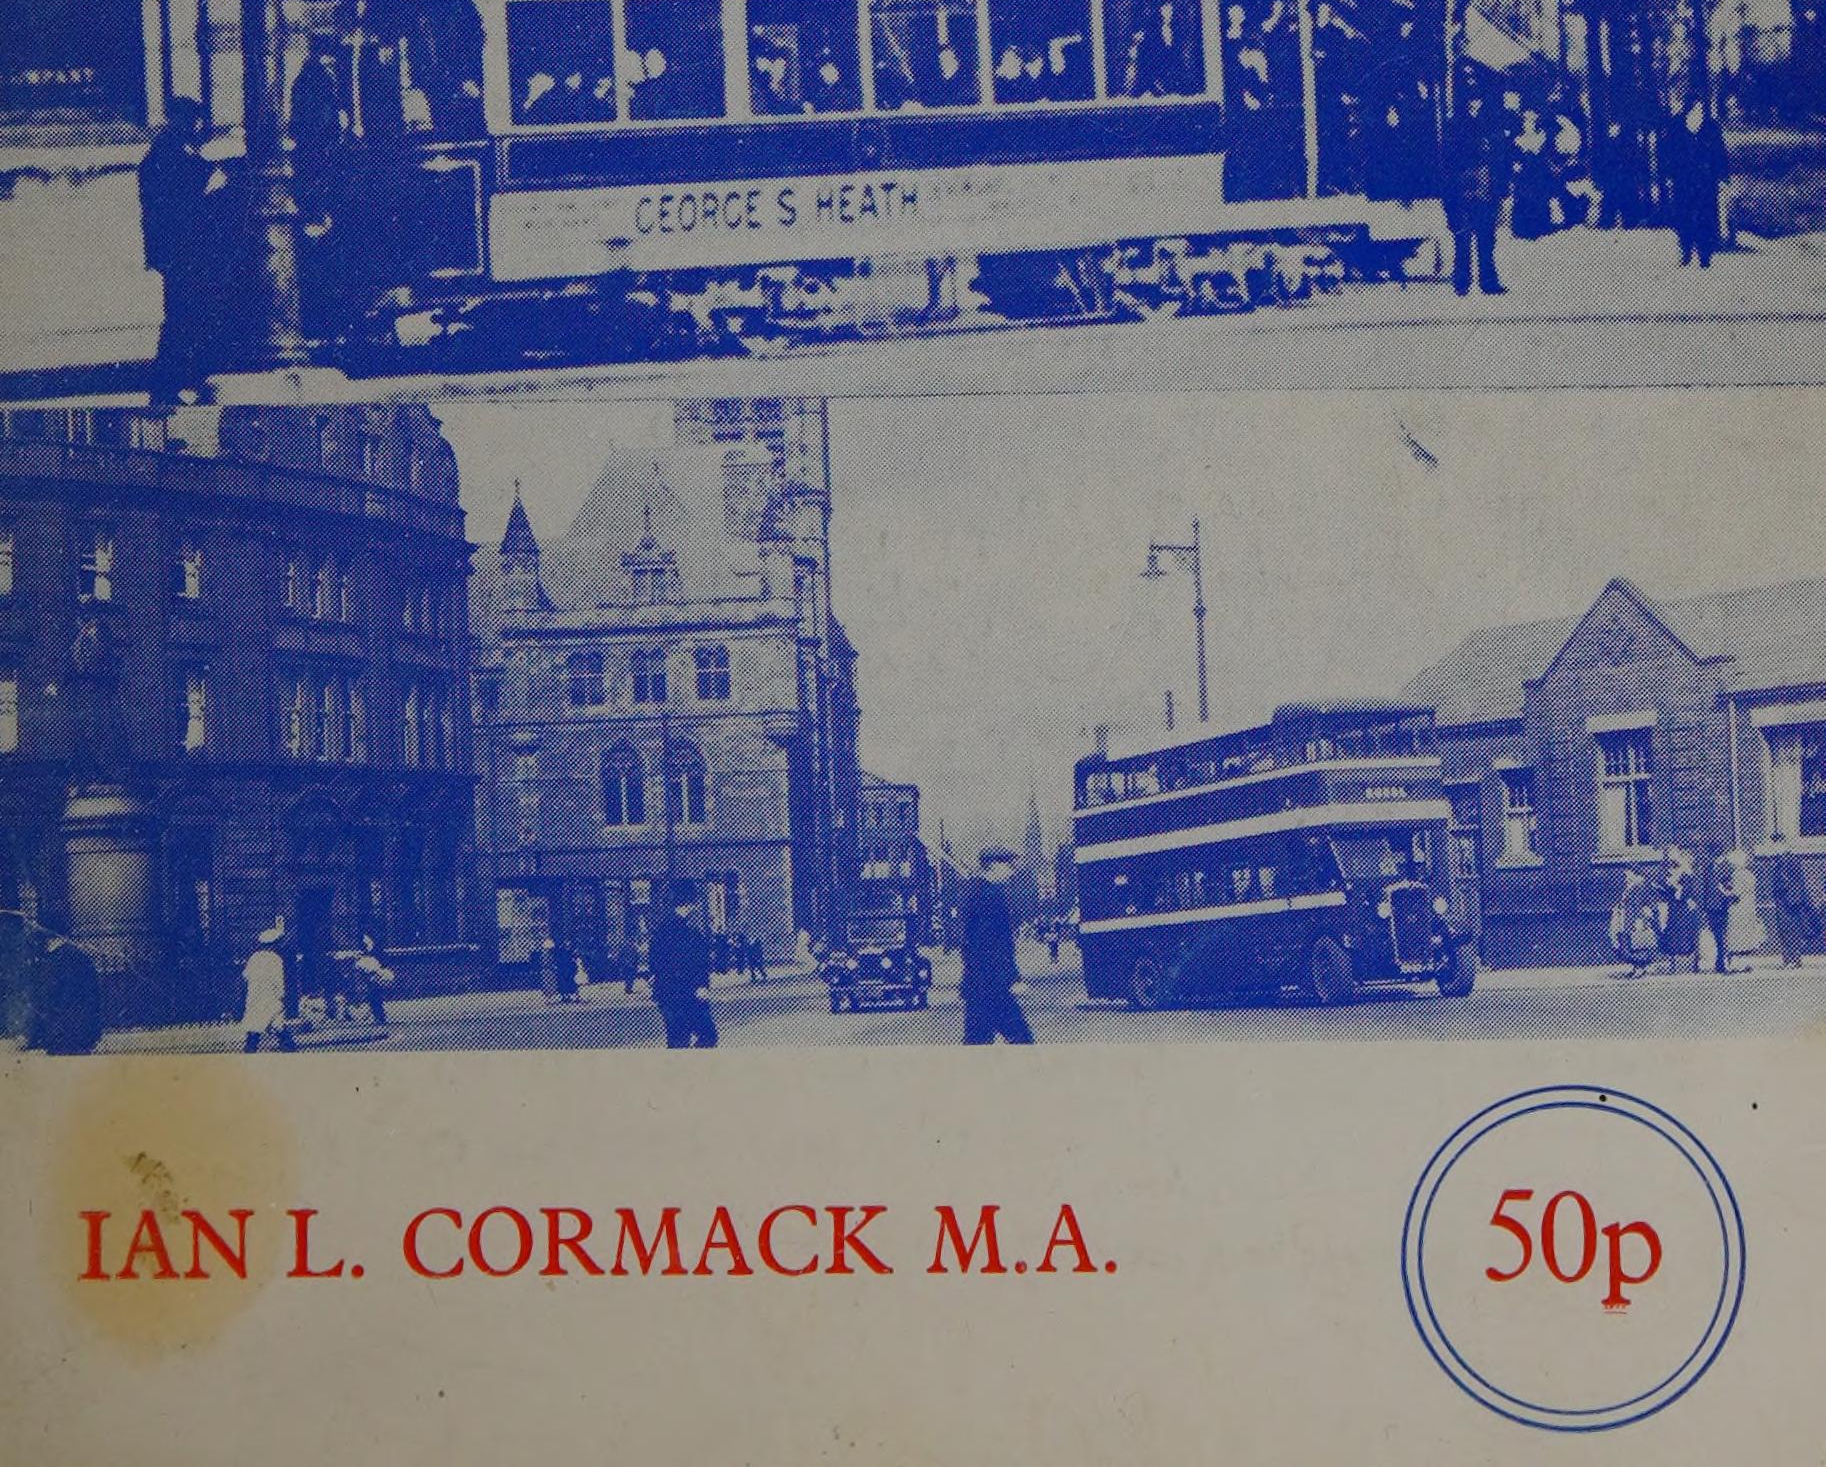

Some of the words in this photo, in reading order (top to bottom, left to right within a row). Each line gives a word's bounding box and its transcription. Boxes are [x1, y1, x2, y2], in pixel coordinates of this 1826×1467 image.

[815, 181, 919, 224] HEATH
[80, 1208, 252, 1281] IAN
[287, 1208, 365, 1279] L.
[403, 1205, 892, 1279] CORMACK
[928, 1204, 1117, 1276] M.A.
[1486, 1189, 1663, 1309] 50p
